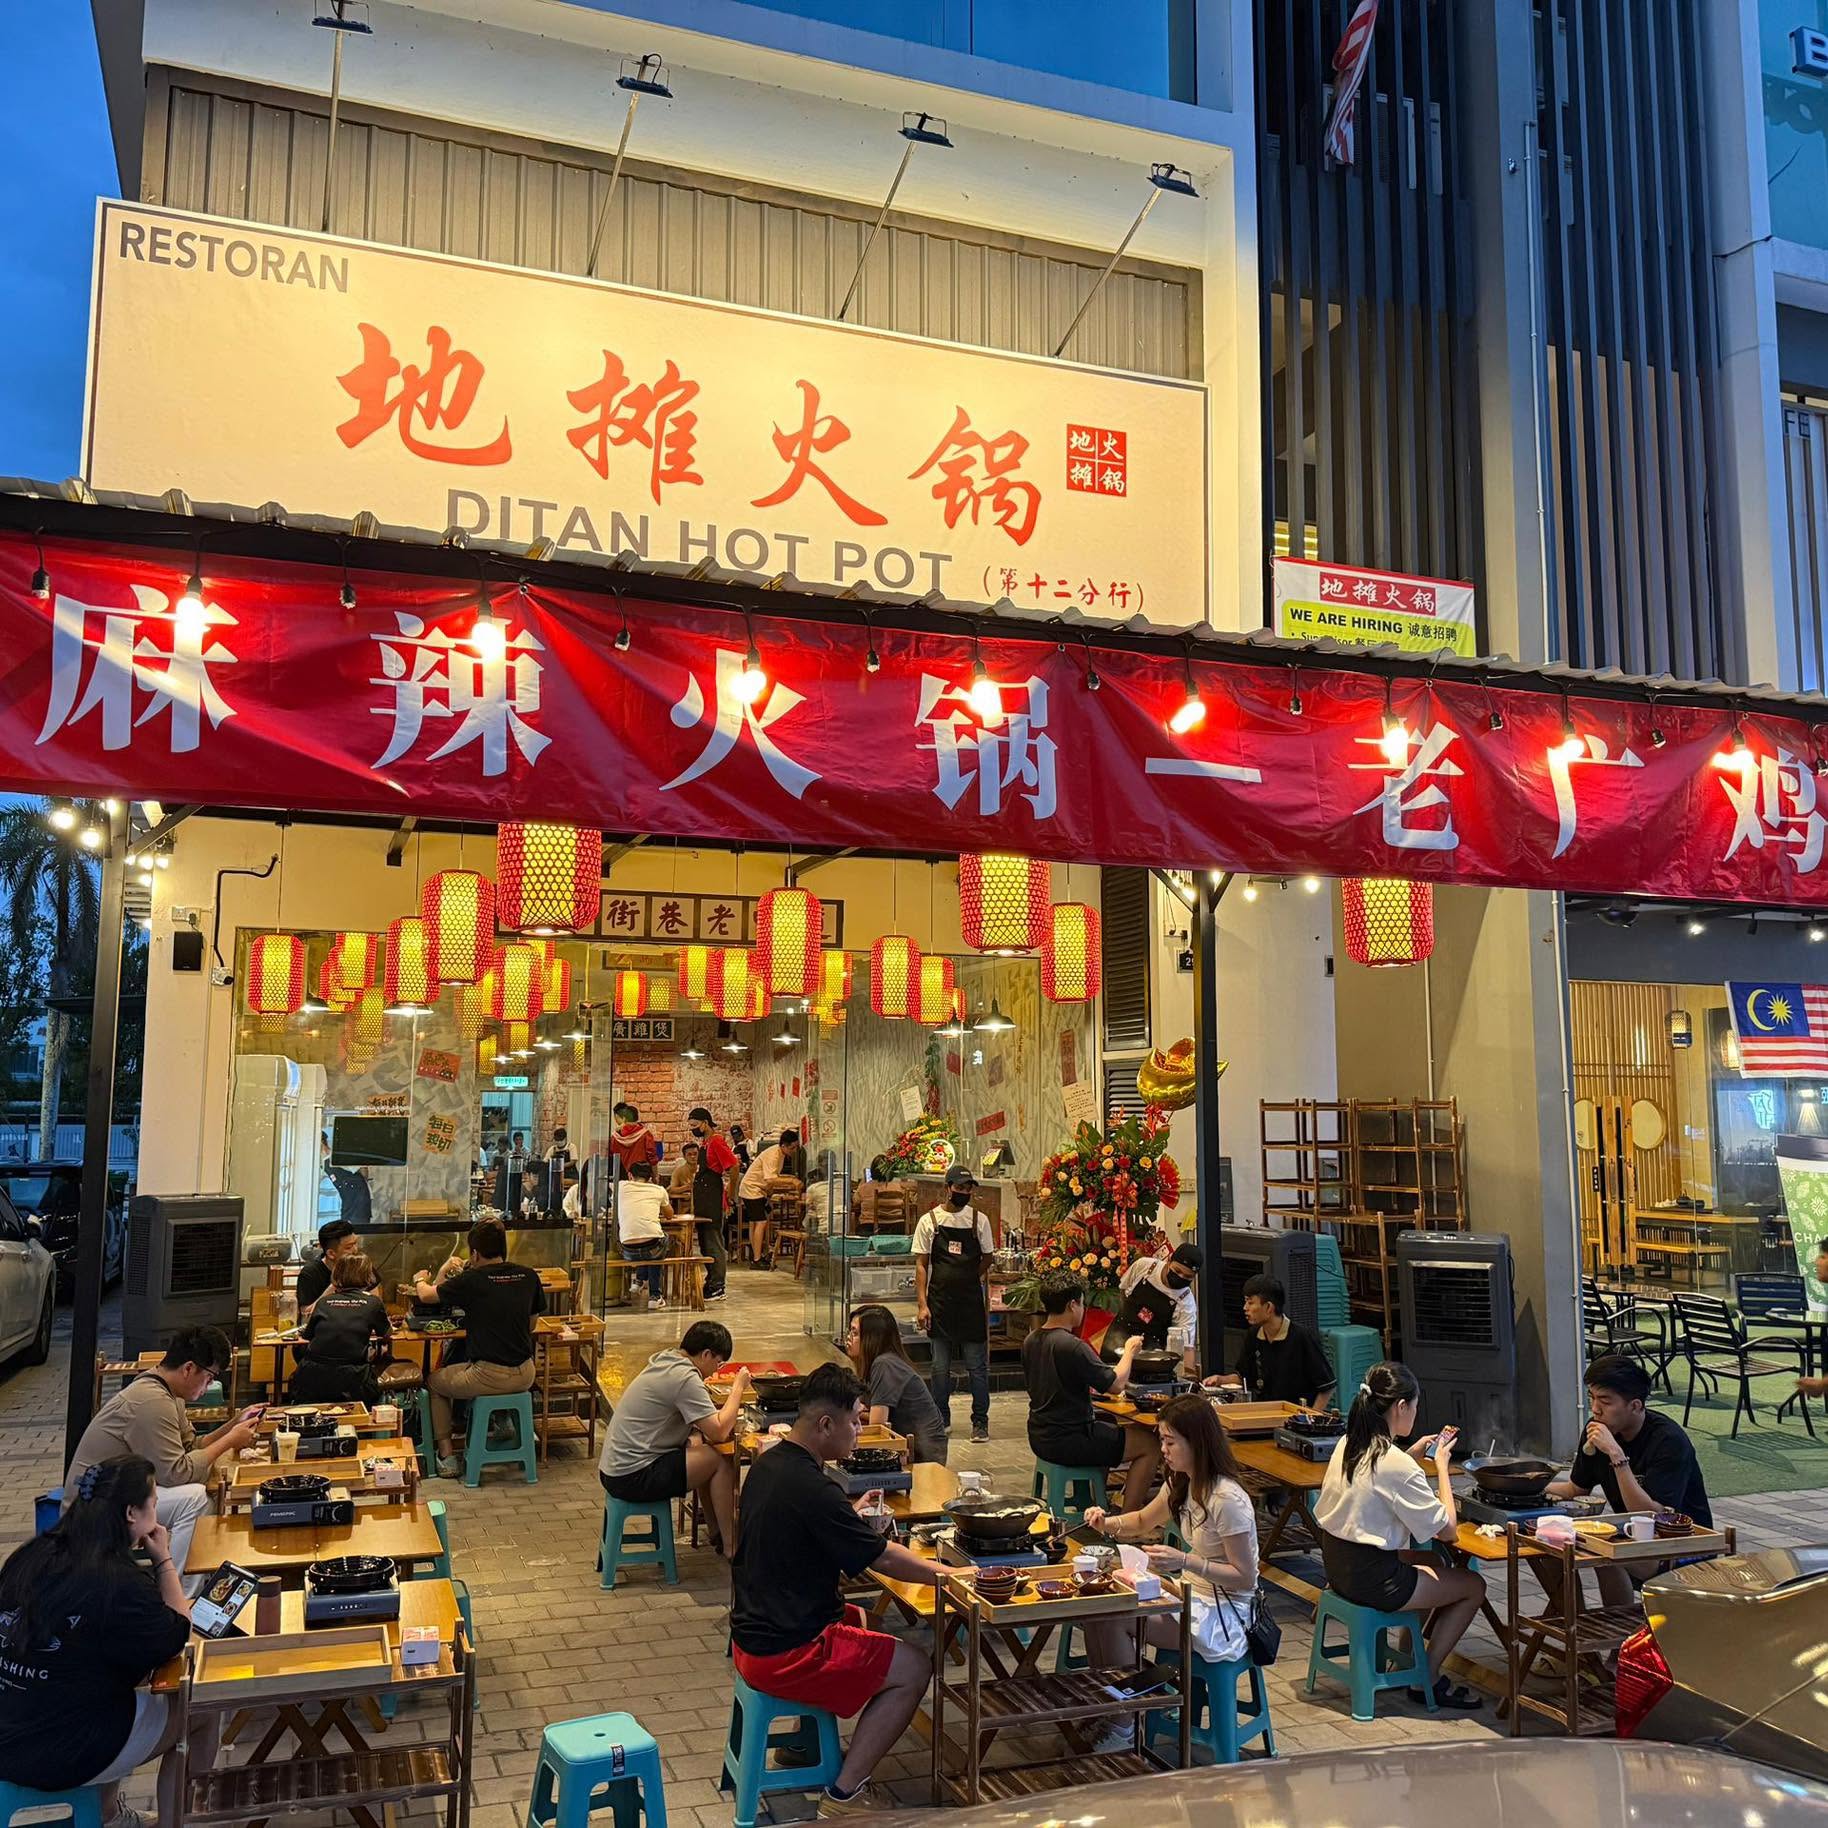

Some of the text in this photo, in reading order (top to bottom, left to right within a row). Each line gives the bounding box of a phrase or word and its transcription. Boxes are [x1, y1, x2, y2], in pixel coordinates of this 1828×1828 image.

[119, 222, 349, 294] RESTORAN
[335, 322, 1042, 546] 地摊火锅
[447, 488, 953, 591] DITAN HOT POT
[1290, 608, 1457, 642] WE ARE HIRING 诚意招聘
[1321, 577, 1435, 613] 地摊火锅
